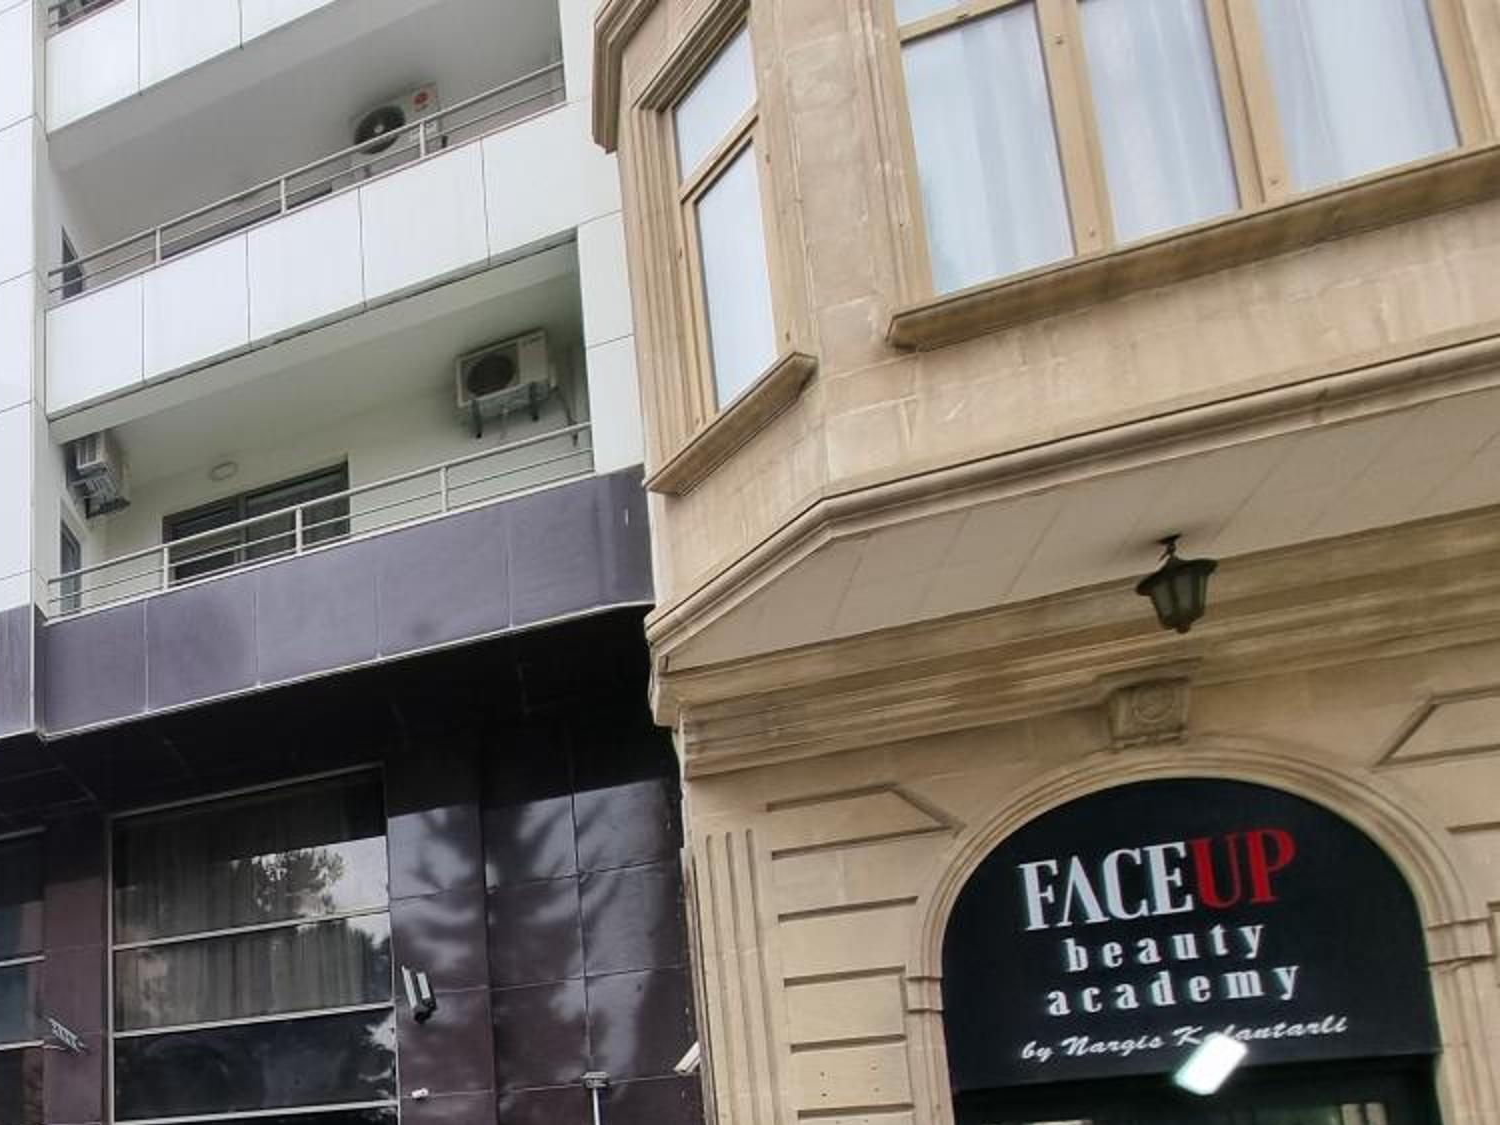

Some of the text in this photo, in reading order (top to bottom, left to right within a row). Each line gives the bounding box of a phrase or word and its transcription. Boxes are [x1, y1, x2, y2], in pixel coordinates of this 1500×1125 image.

[1062, 923, 1266, 972] beauty
[1045, 964, 1300, 1017] academy
[1021, 1014, 1348, 1062] by Nargis Klantarli
